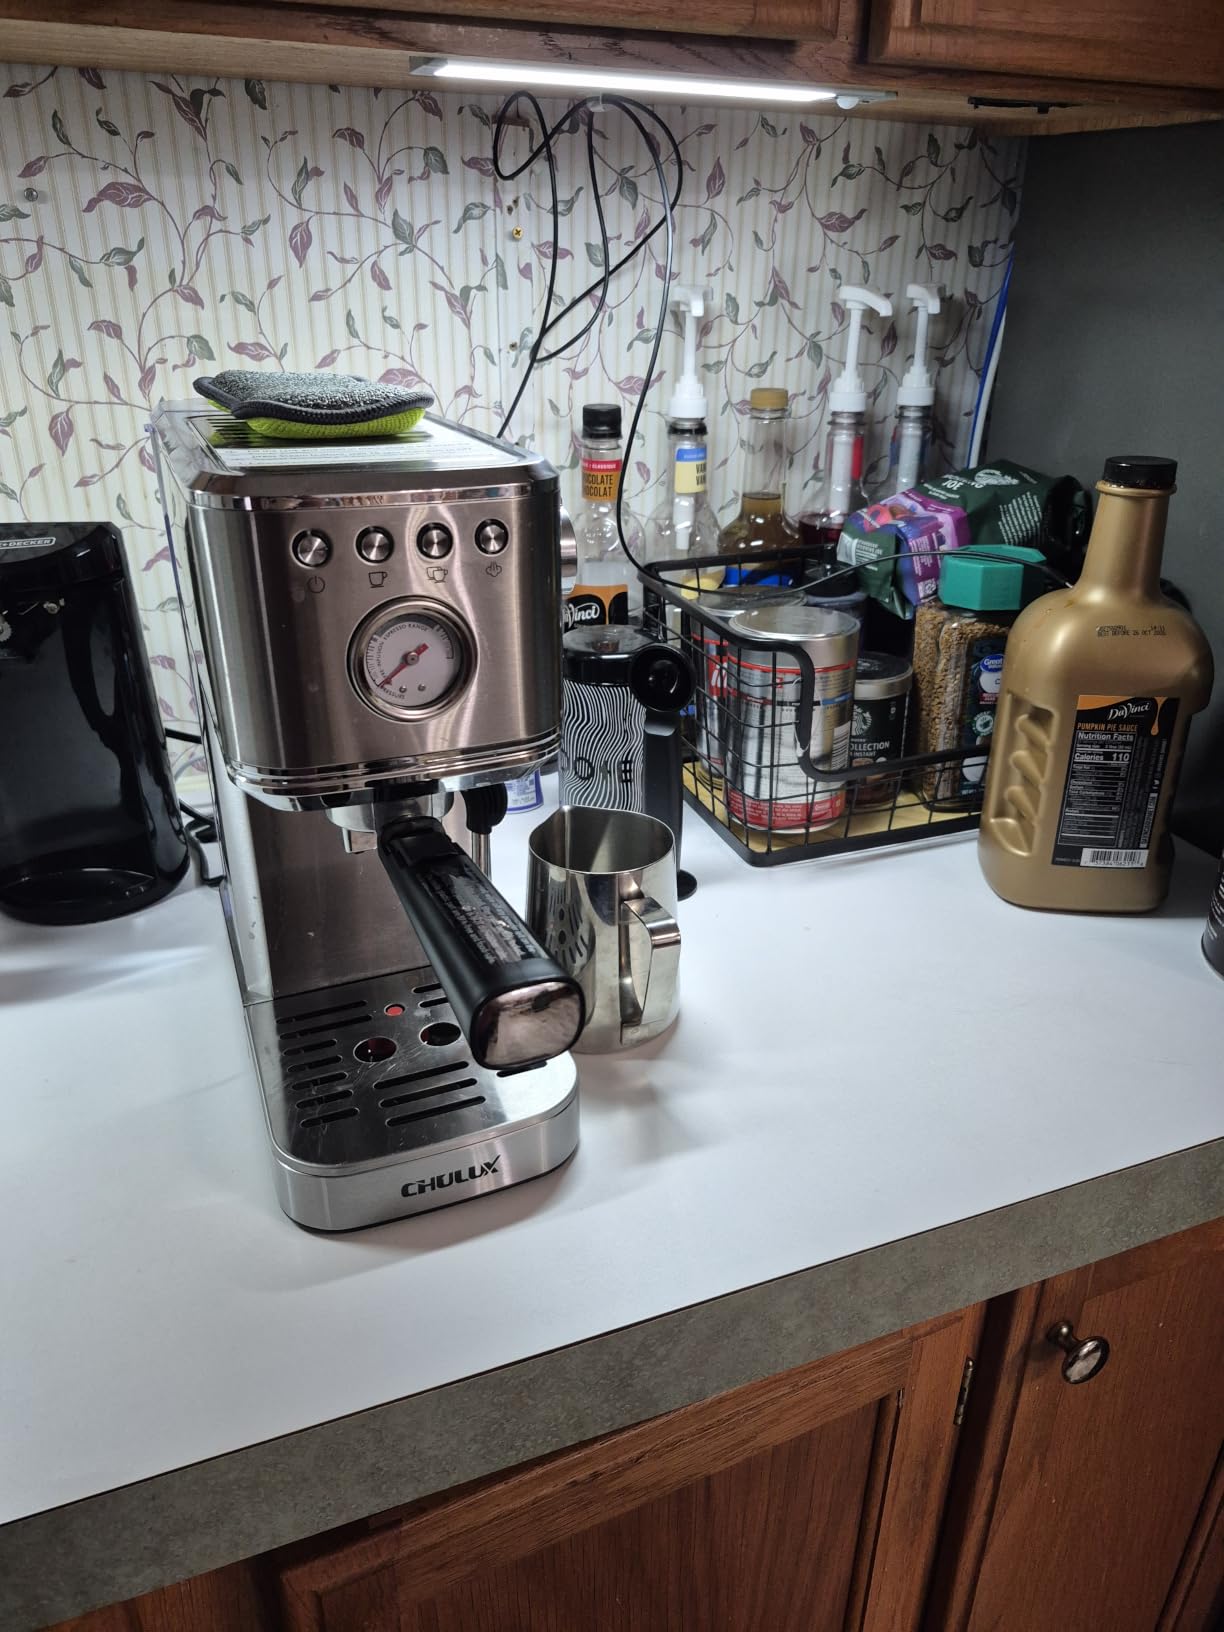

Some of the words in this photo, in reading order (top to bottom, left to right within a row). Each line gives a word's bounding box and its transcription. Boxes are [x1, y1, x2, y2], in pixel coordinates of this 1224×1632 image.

[585, 474, 613, 485] COLATE
[941, 480, 963, 490] JOE
[585, 486, 612, 497] OCOLAT
[562, 602, 600, 628] aVinci
[408, 623, 428, 632] RANGE
[1107, 702, 1150, 720] DaVinci
[1077, 722, 1105, 731] PUMPKIN
[1106, 723, 1117, 731] PIE
[1118, 724, 1138, 732] SAUCE
[1078, 732, 1111, 740] Nutrition
[1113, 733, 1134, 741] Facts
[849, 740, 890, 751] OLLECTION
[1074, 752, 1104, 760] Calories
[1112, 753, 1130, 761] 110
[401, 1154, 500, 1197] CHULUX
